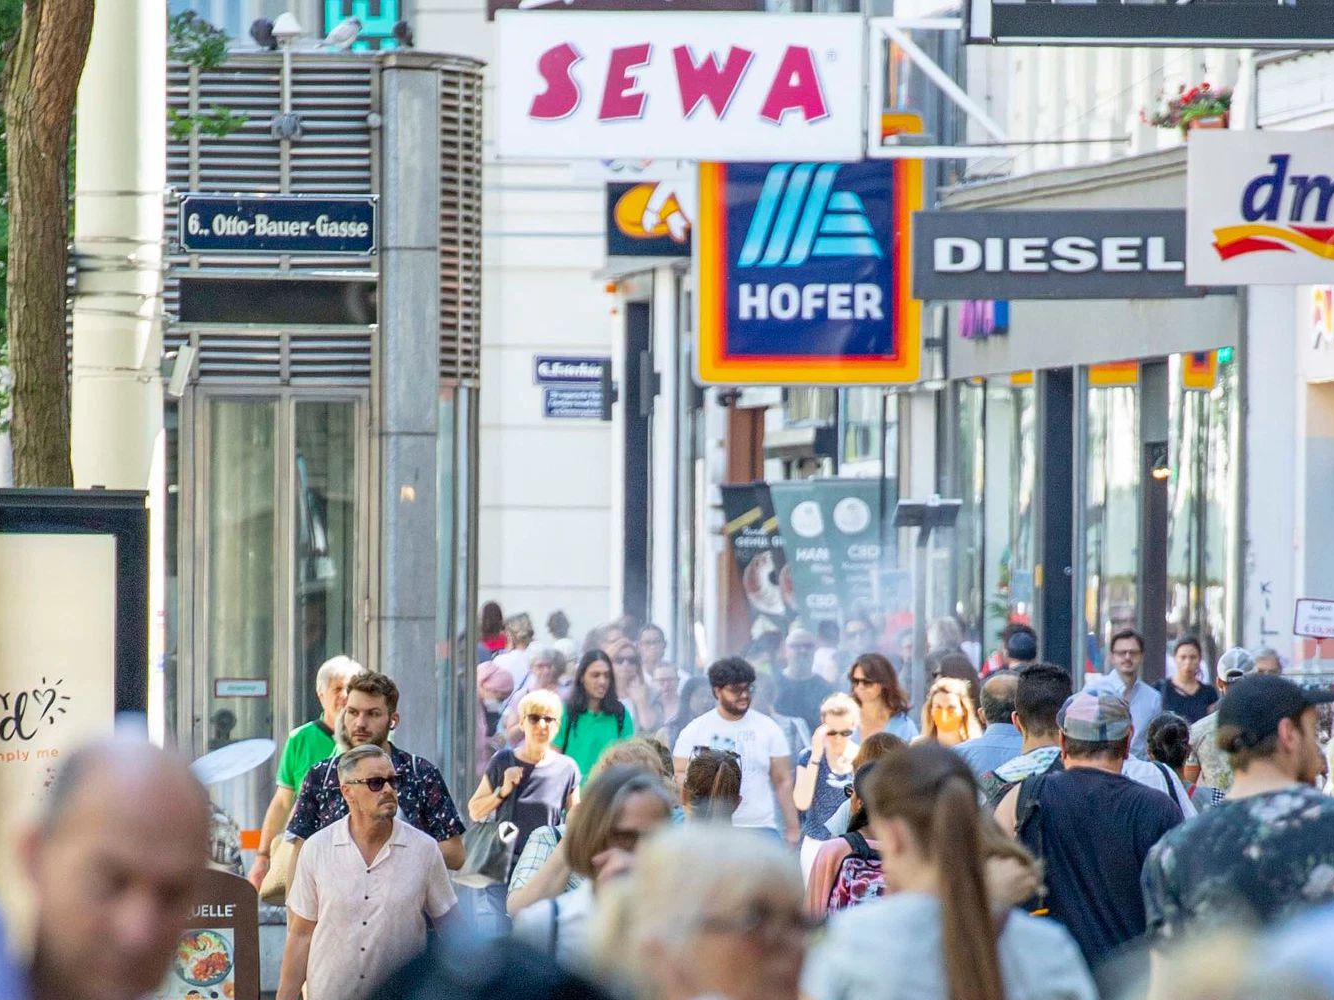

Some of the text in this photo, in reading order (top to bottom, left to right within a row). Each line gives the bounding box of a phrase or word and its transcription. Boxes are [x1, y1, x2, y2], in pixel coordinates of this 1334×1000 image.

[528, 41, 831, 125] SEWA
[212, 213, 369, 238] Otto-Bauer-Gasse
[933, 236, 1185, 273] DIESEL
[738, 282, 884, 320] HOFER
[36, 748, 60, 758] me
